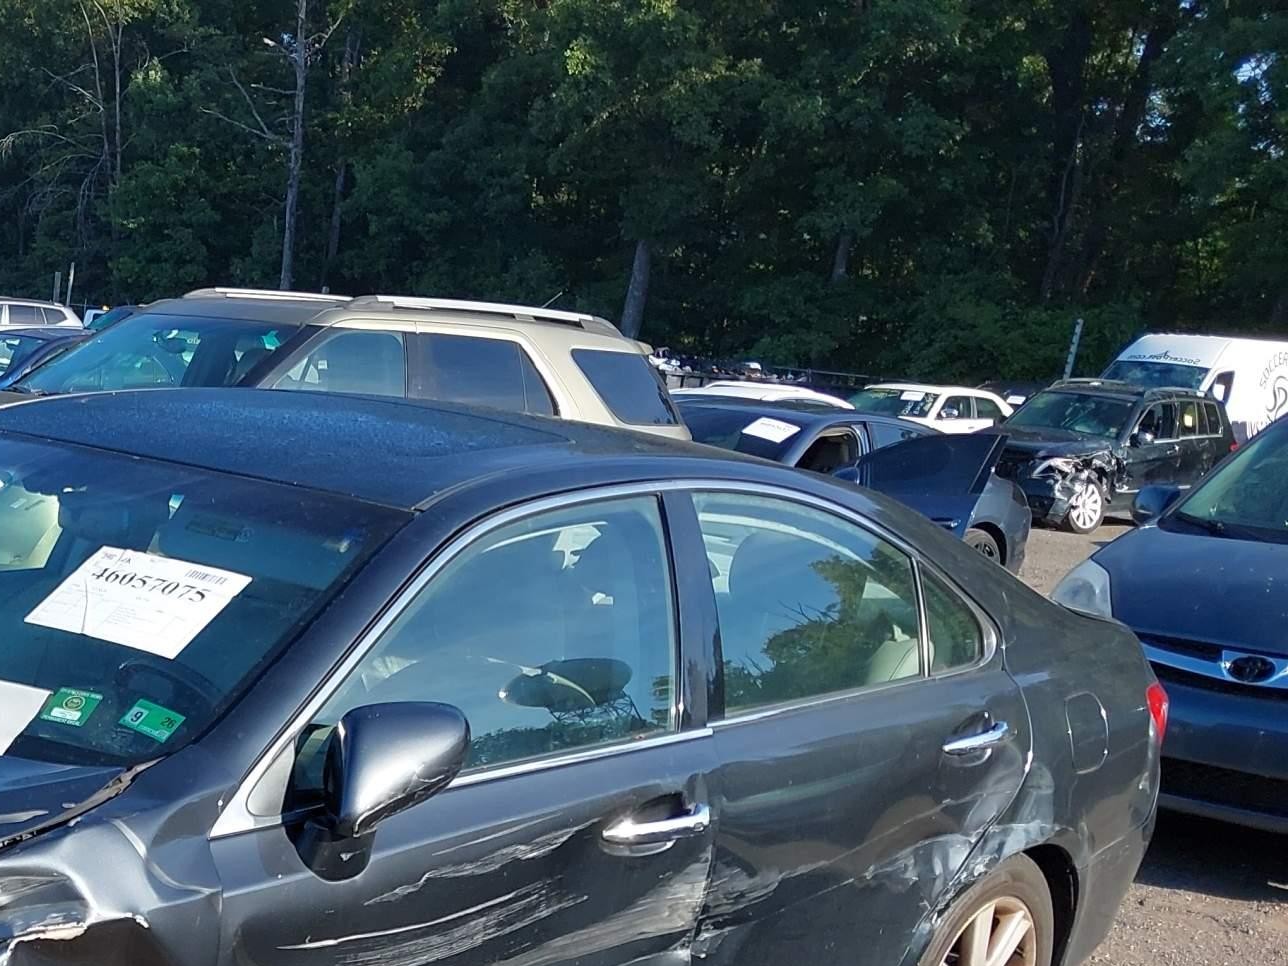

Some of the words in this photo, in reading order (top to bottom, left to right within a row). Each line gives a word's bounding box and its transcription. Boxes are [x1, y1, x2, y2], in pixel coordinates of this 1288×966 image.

[91, 567, 211, 602] 46057075
[130, 711, 144, 723] 9
[161, 716, 176, 729] 26
